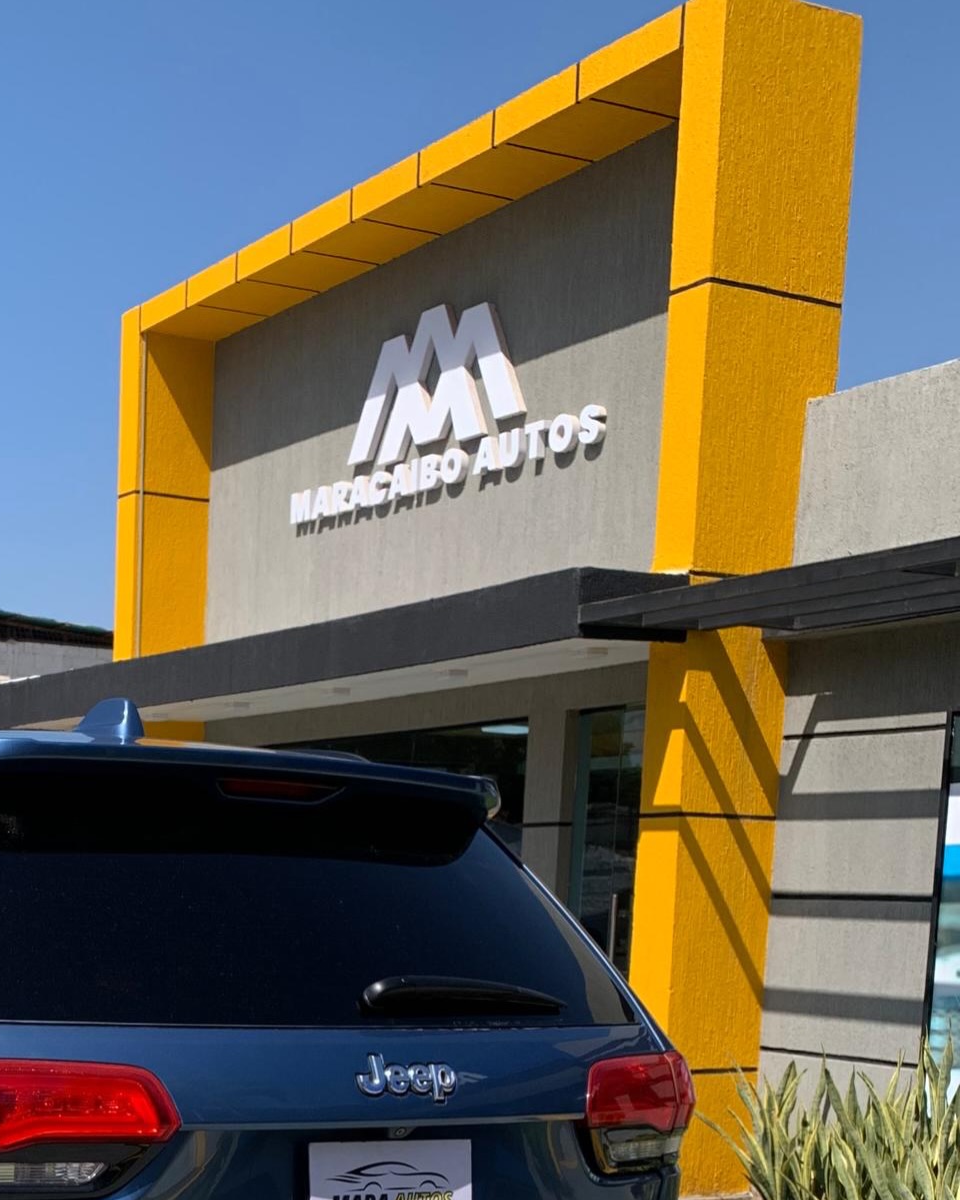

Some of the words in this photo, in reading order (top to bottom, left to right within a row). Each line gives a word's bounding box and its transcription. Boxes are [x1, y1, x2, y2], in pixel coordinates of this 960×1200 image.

[290, 447, 469, 526] MARACAIBO
[472, 403, 607, 477] AUTOS
[355, 1053, 458, 1104] Jeep
